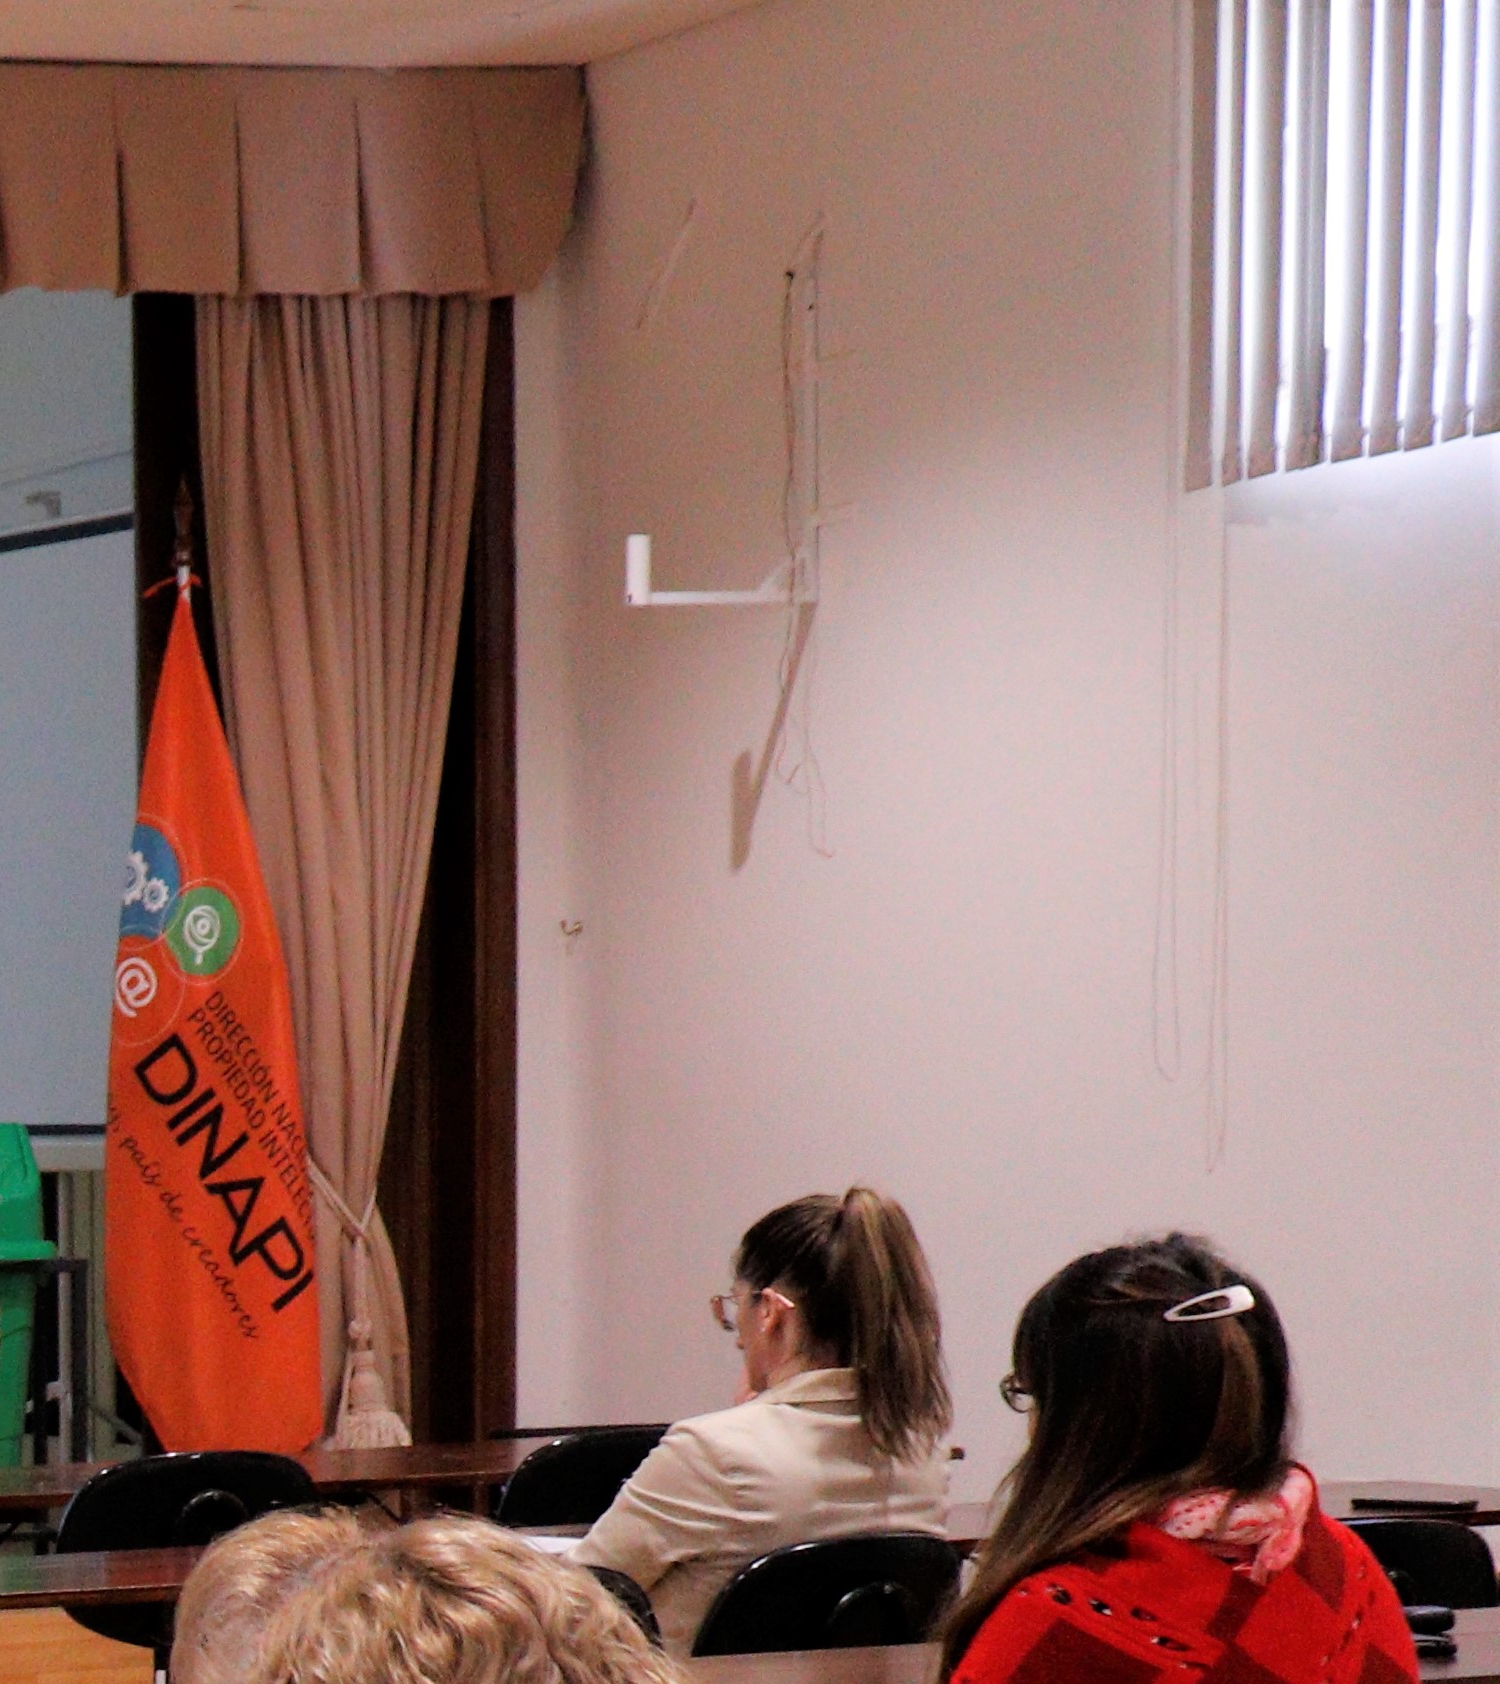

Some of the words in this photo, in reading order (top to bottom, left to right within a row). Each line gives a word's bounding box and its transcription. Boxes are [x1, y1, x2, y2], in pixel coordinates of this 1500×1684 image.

[187, 1006, 267, 1129] PROPIEDAD
[204, 990, 280, 1103] DIRECCIÓN
[134, 1032, 314, 1313] DINAPI
[182, 1226, 260, 1339] creadores
